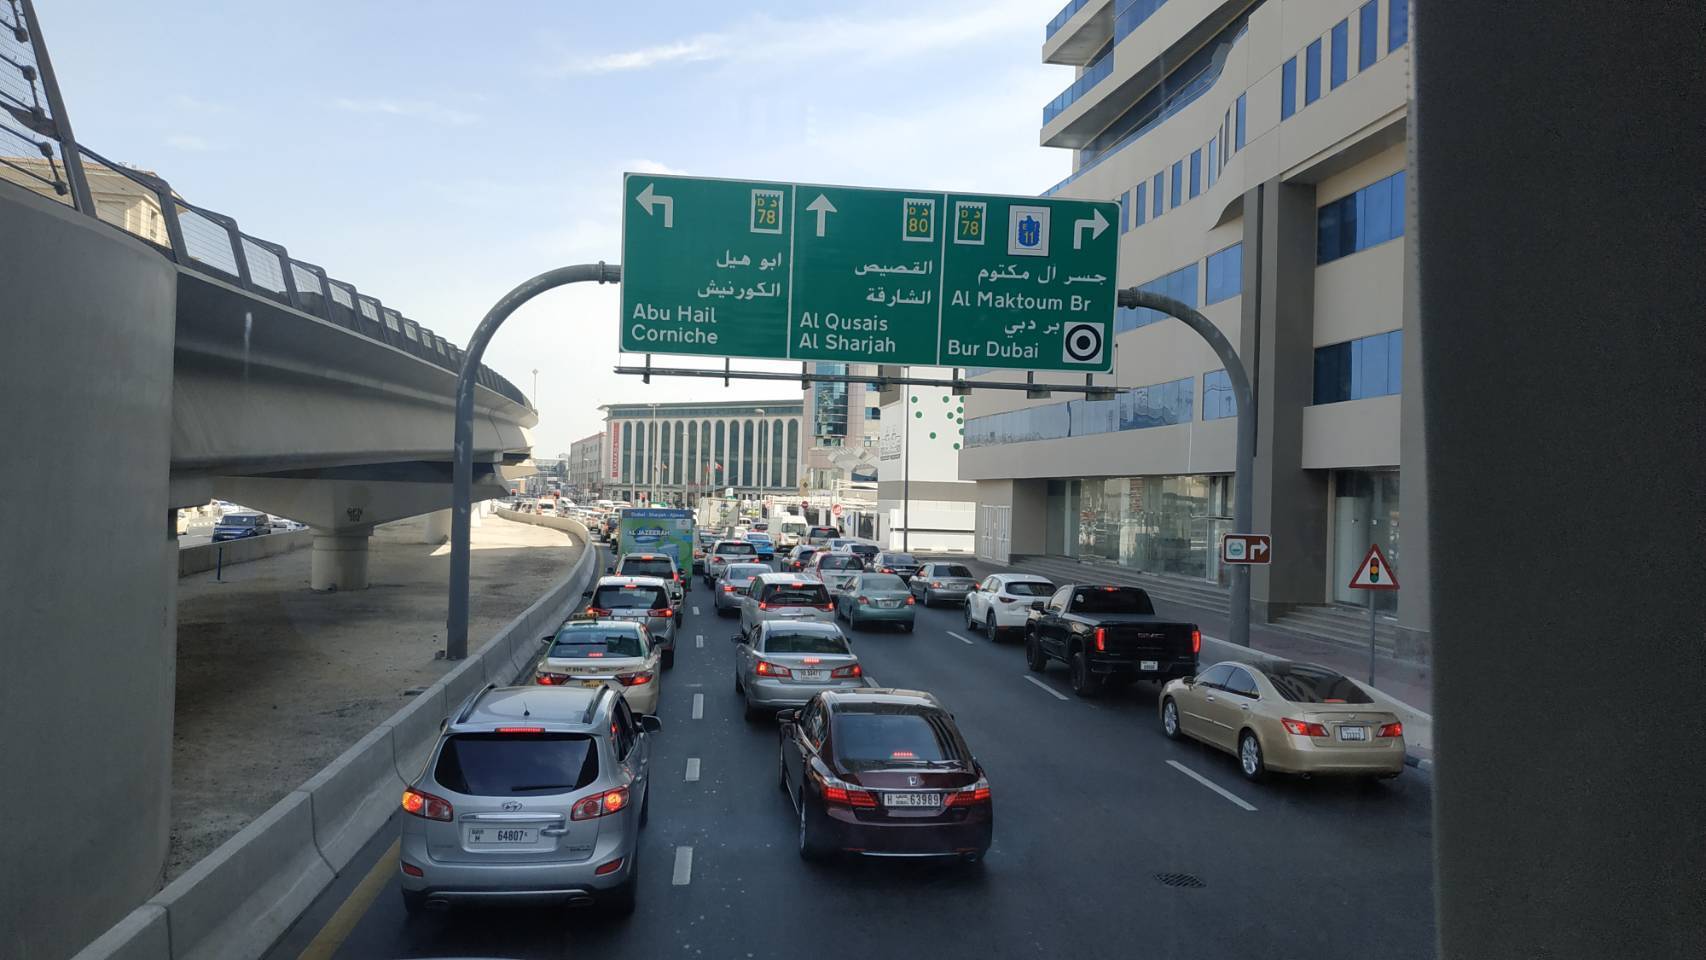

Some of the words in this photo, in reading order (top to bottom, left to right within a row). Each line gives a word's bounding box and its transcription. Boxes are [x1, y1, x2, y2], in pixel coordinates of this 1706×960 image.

[758, 210, 776, 224] 78
[909, 218, 928, 232] 80
[962, 221, 978, 235] 78
[1024, 232, 1034, 243] 11
[716, 250, 750, 269] هيل
[759, 252, 782, 270] ابو
[855, 260, 932, 276] القصيص
[978, 265, 1029, 286] مكتوم
[1064, 274, 1107, 285] جسر
[697, 280, 780, 299] الكورنيش
[866, 287, 931, 306] الشارقة
[952, 290, 970, 306] Al
[977, 291, 1062, 310] Maktoum
[1071, 296, 1091, 311] Br
[633, 304, 670, 320] Abu
[678, 305, 717, 323] Hail
[800, 312, 819, 328] Al
[825, 313, 888, 331] Qusais
[632, 324, 718, 344] Corniche
[1005, 320, 1036, 338] دبي
[1043, 321, 1060, 334] بر
[800, 333, 818, 349] Al
[825, 334, 896, 354] Sharjah
[948, 340, 980, 356] Bur
[987, 341, 1038, 358] Dubai
[910, 794, 938, 805] 63989
[498, 830, 524, 841] 64807
